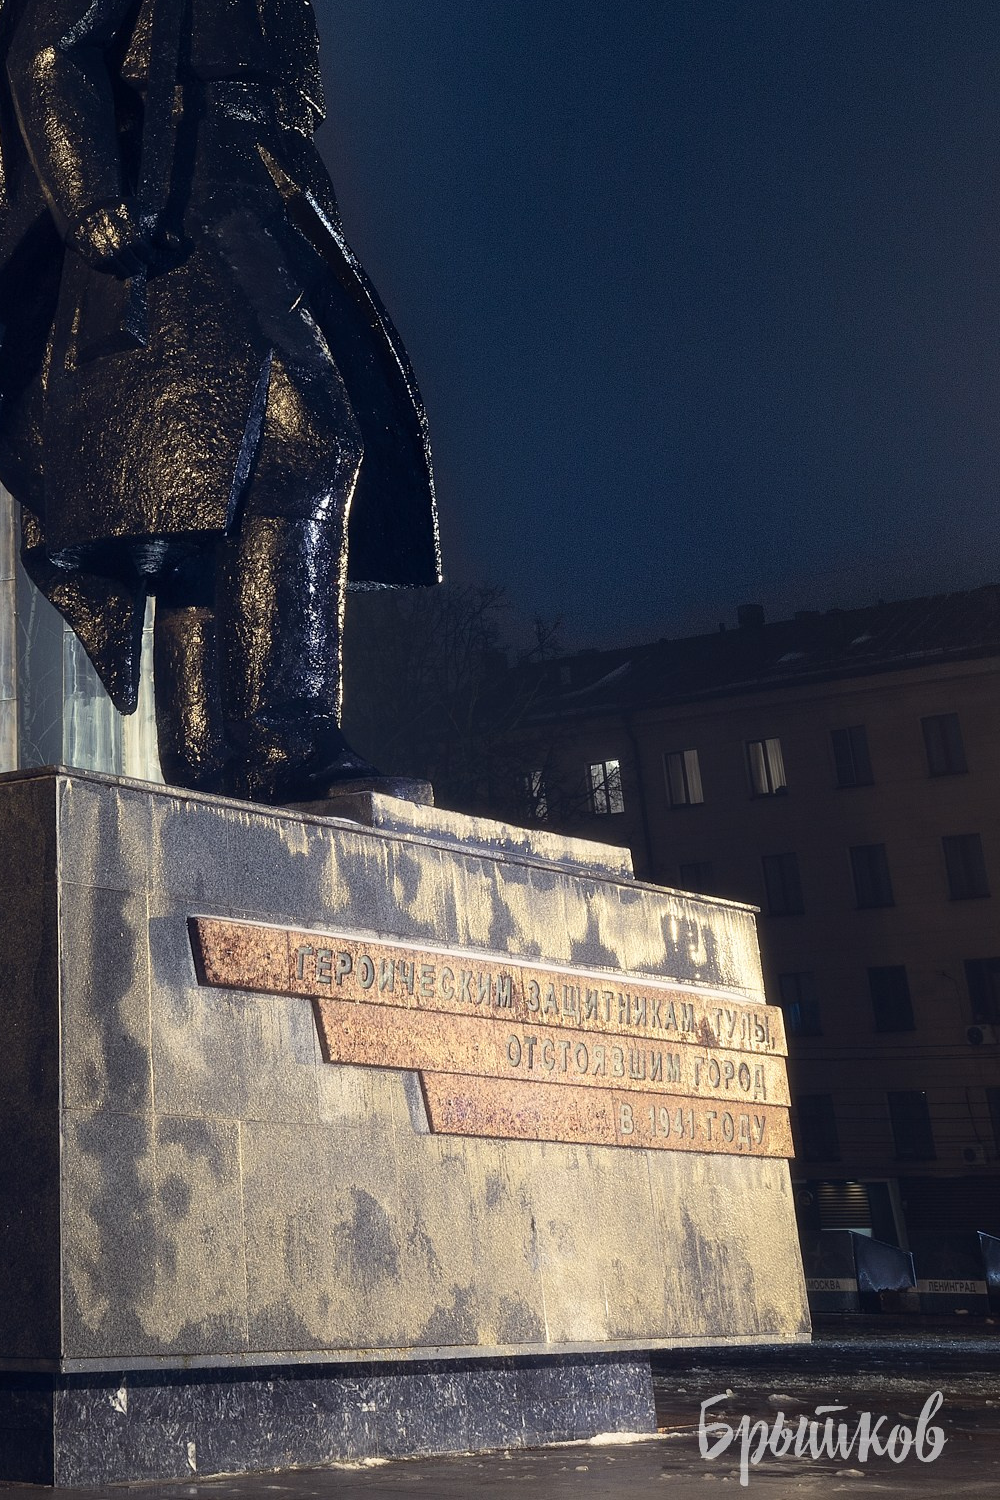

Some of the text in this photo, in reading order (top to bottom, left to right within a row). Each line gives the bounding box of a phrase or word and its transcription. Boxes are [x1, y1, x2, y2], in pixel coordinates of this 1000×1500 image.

[296, 944, 512, 1009] ГЕРОИЧЕСКИМ
[526, 979, 695, 1033] ЗАЩИТНИКАМ
[505, 1034, 768, 1101] ОТСТОЯВШИМ ГОРОД
[618, 1103, 767, 1151] В 1941 ГОДУ
[807, 1279, 841, 1290] МОСКВА
[928, 1281, 977, 1293] ЛЕНИНГРАД
